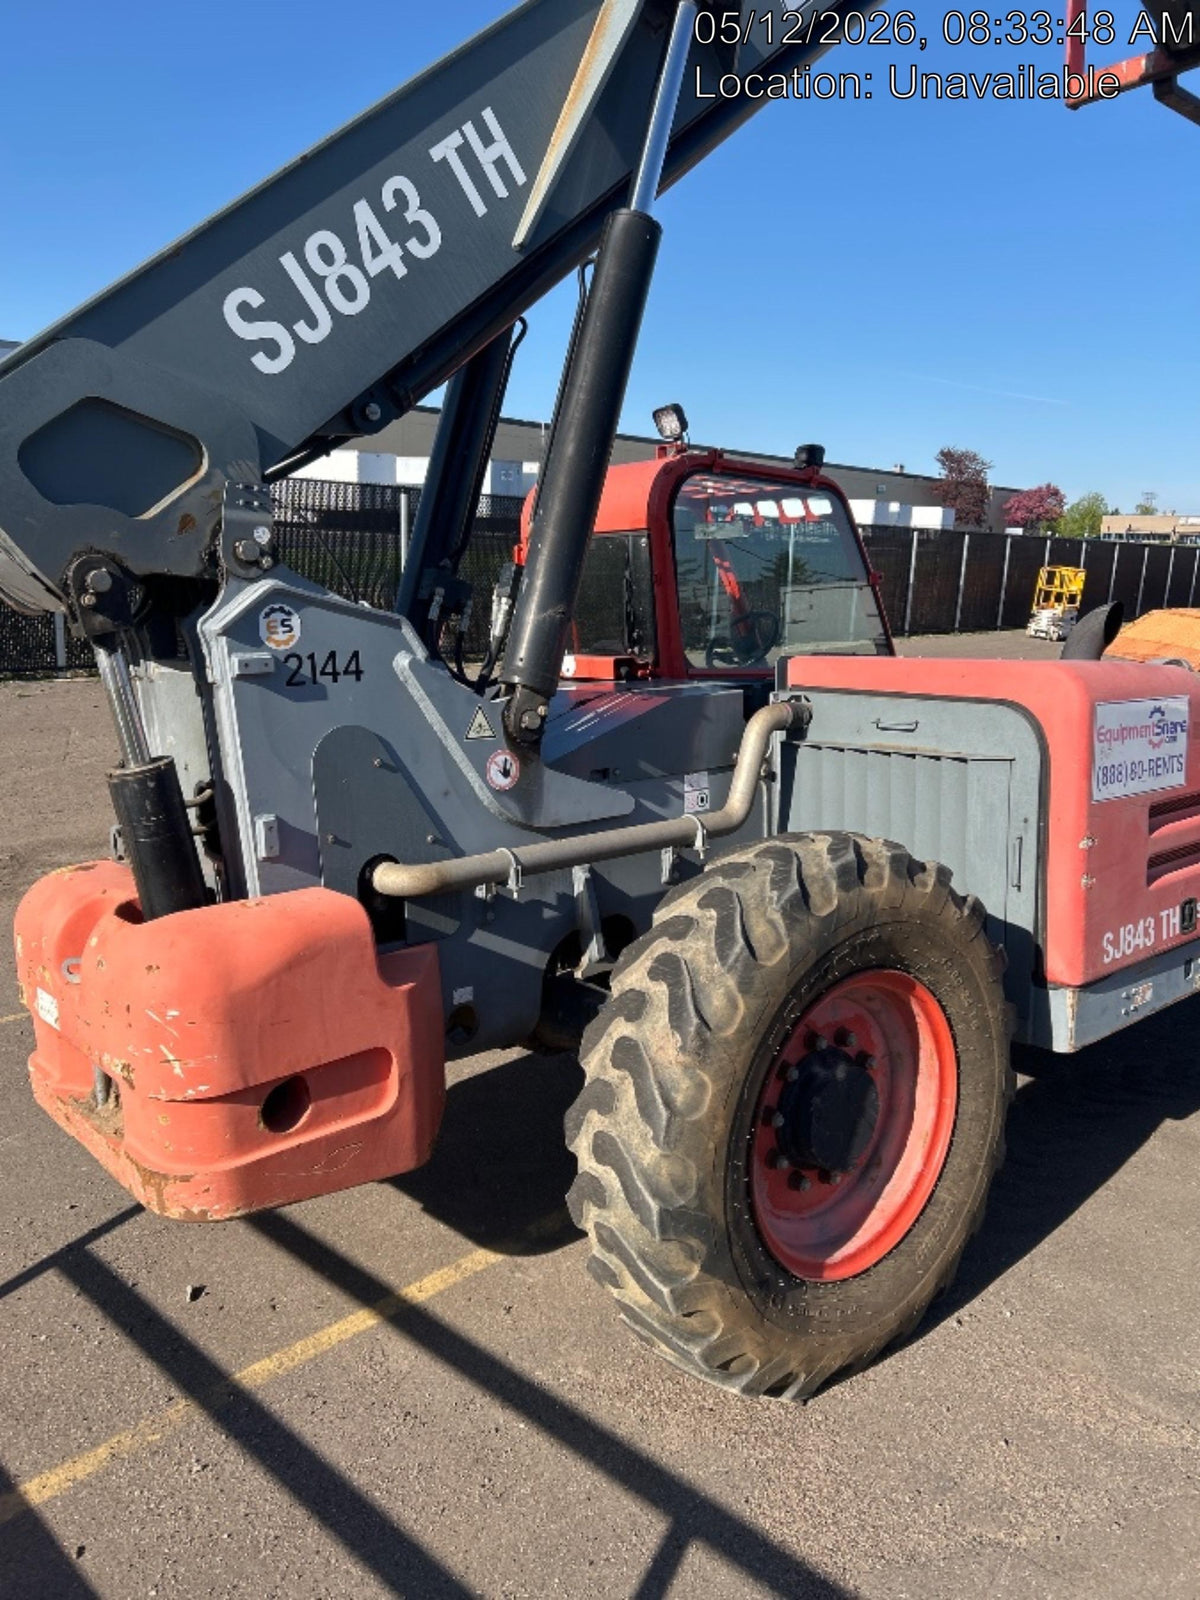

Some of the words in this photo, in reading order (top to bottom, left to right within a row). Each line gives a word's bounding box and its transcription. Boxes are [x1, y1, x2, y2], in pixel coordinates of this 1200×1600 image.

[223, 175, 442, 374] SJ843
[428, 106, 527, 218] TH
[266, 618, 294, 635] ES
[282, 650, 365, 687] 2144
[1103, 916, 1155, 964] SJ843
[1160, 904, 1180, 941] TH
